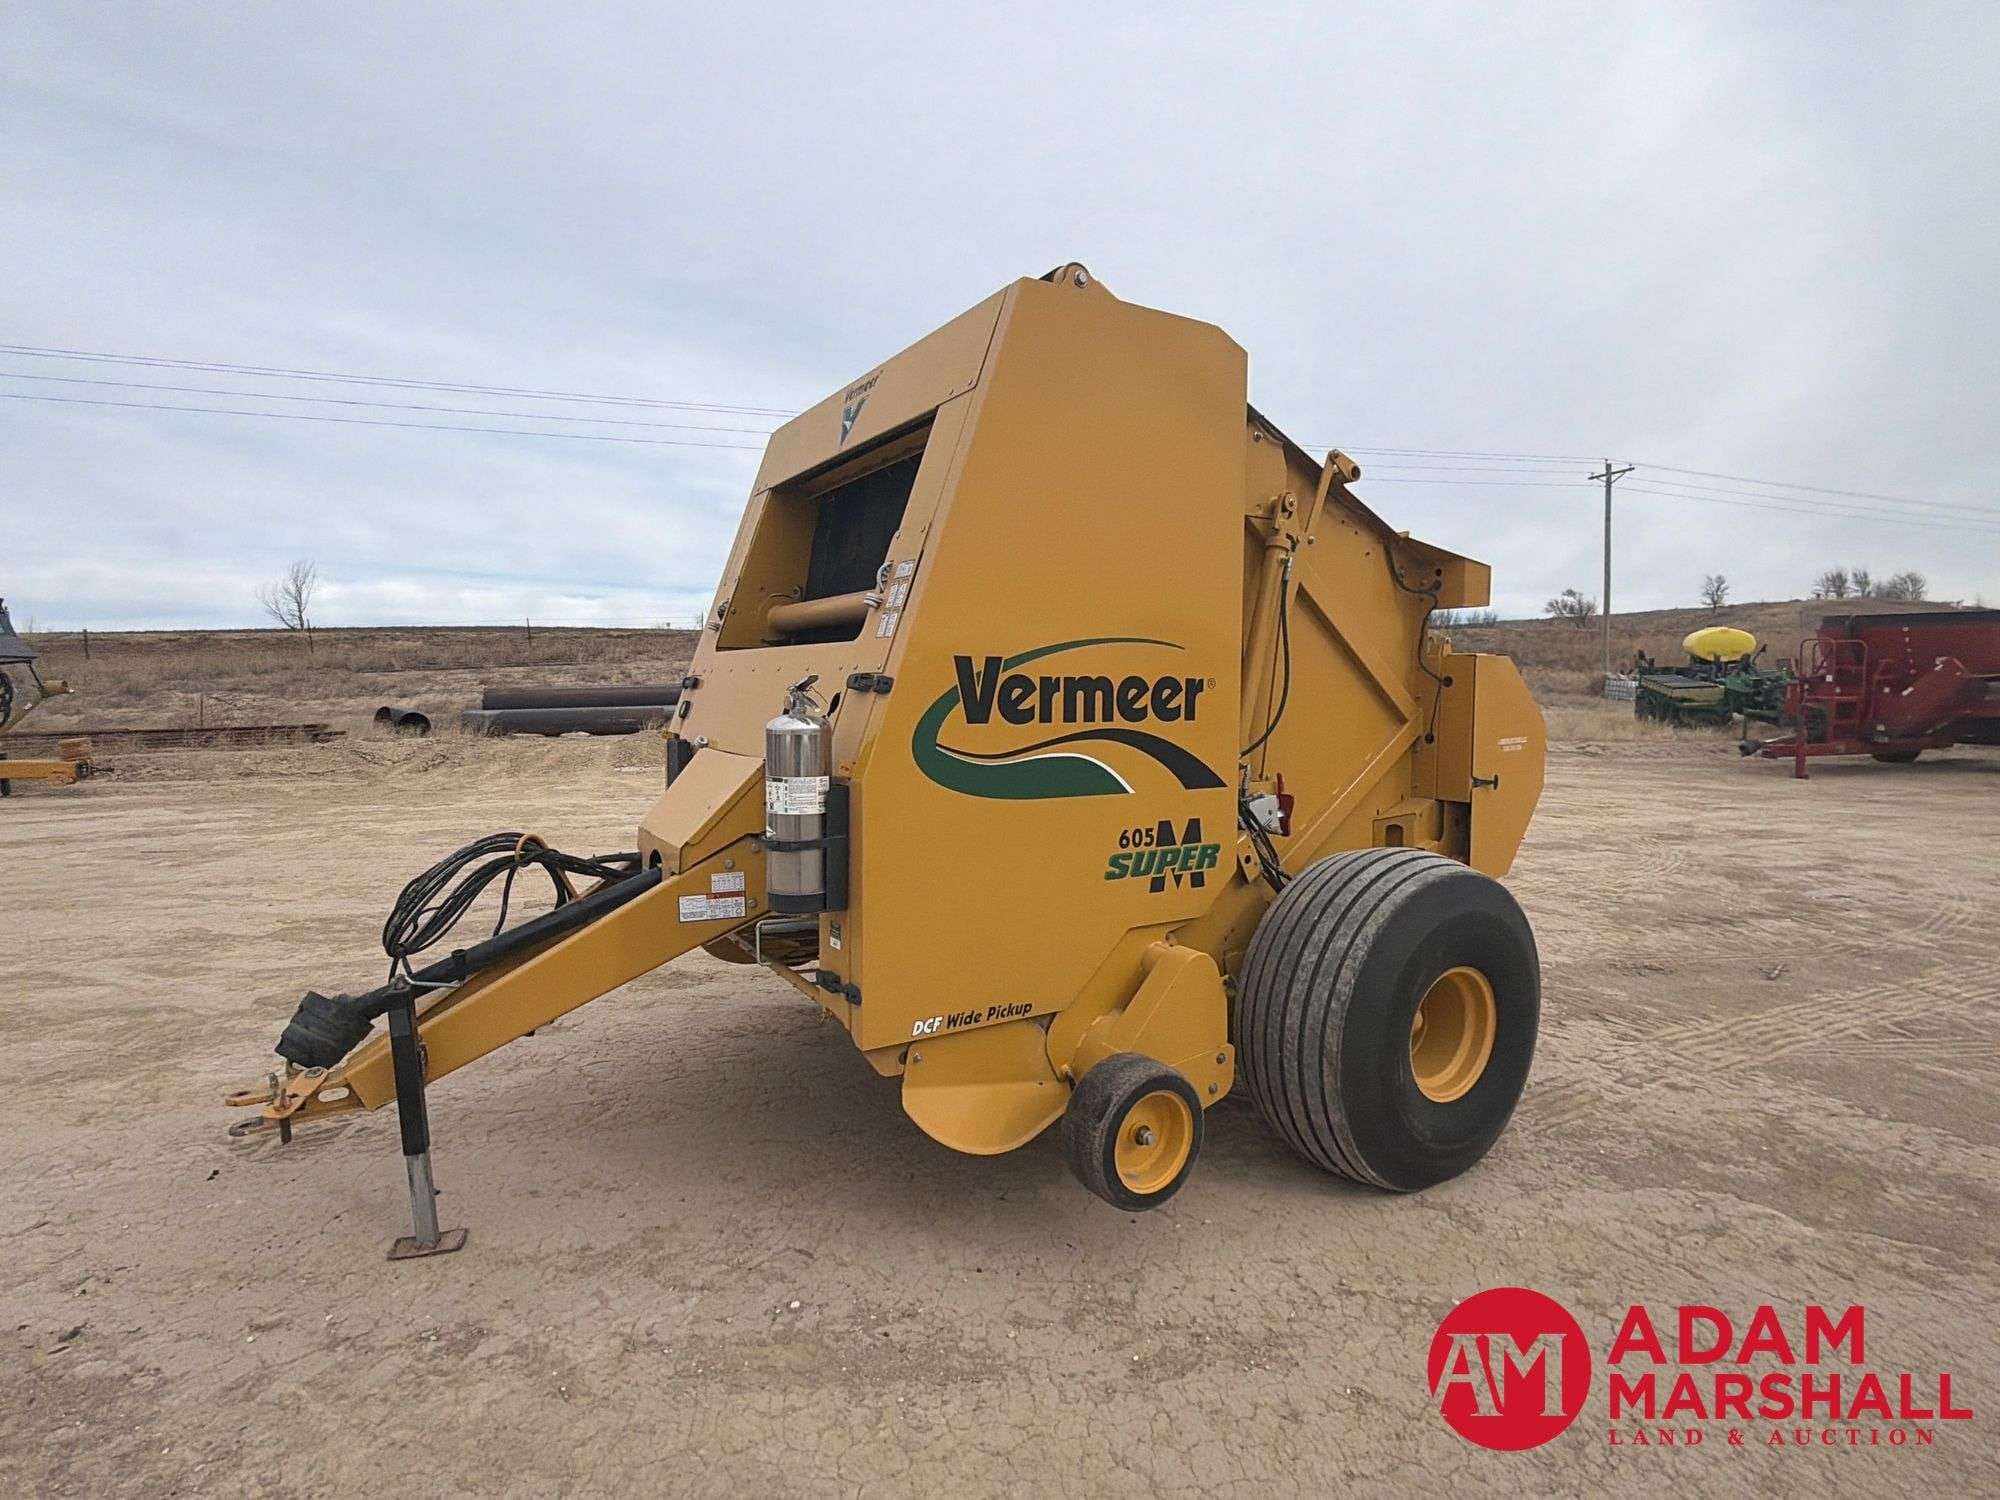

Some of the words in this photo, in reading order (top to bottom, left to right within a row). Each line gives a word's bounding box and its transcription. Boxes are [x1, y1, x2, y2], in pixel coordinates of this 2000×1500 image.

[953, 655, 1205, 725] Vermeer
[1118, 827, 1155, 849] 605
[1103, 843, 1221, 881] SUPER
[911, 1016, 943, 1037] DCF
[945, 1010, 982, 1030] Wide
[986, 1002, 1033, 1021] Pickup
